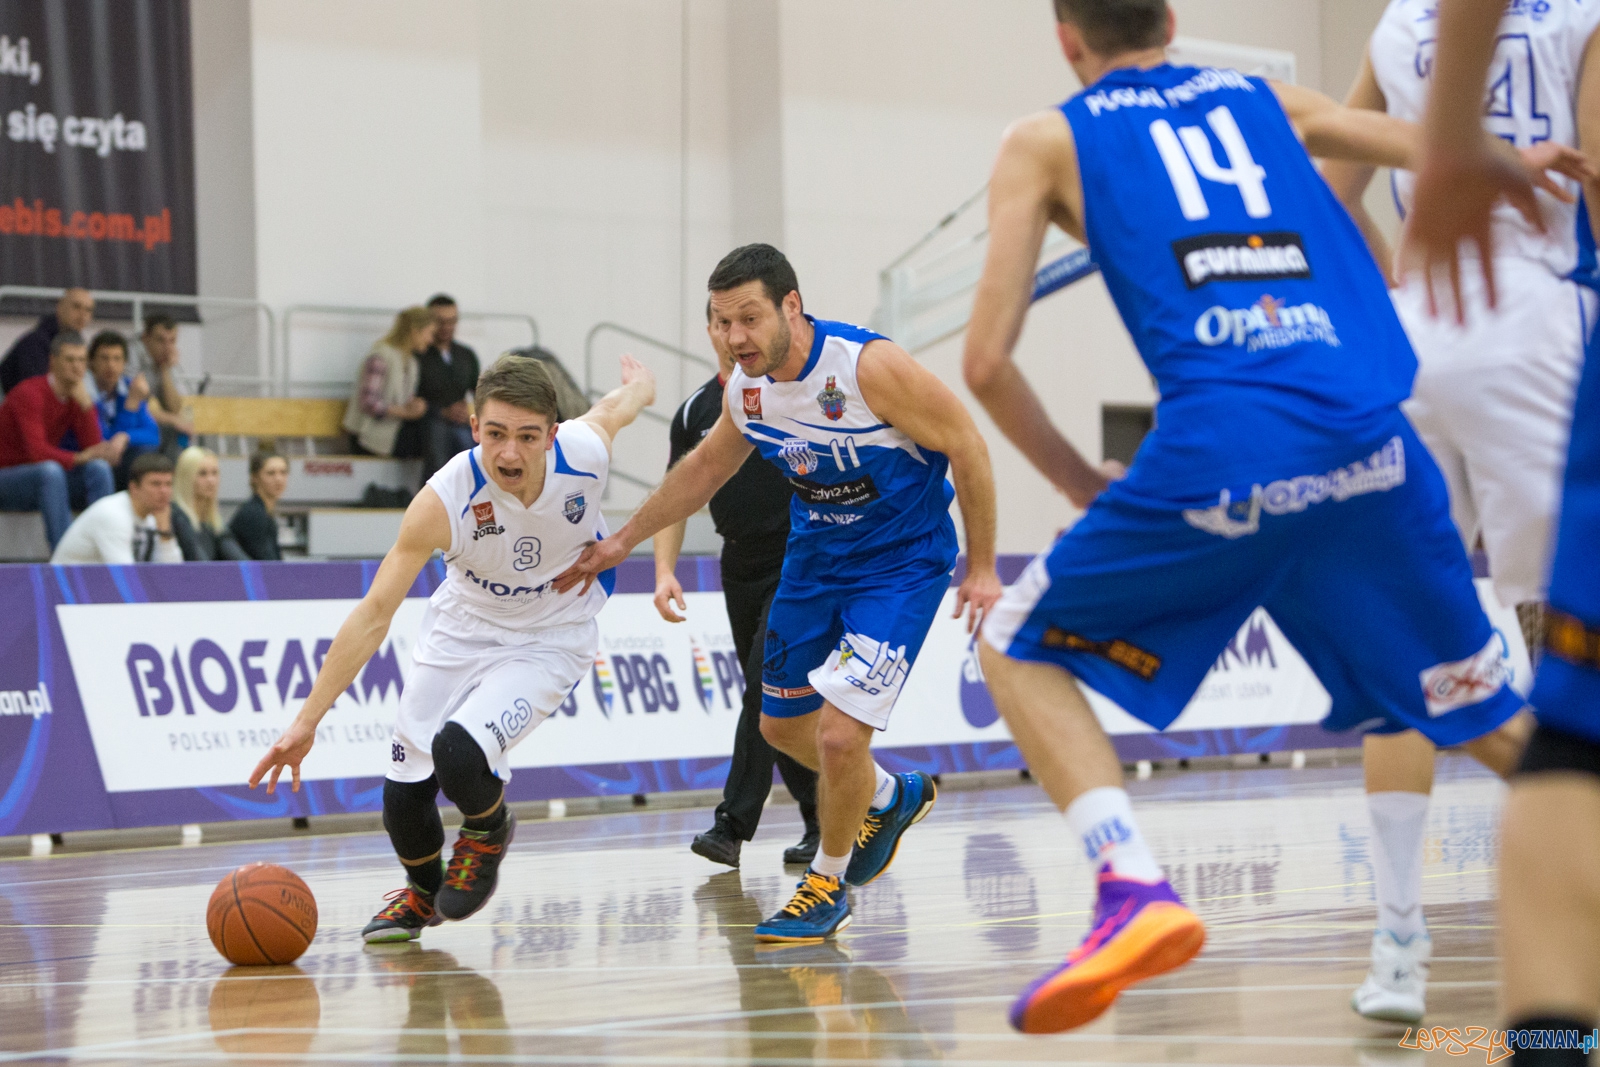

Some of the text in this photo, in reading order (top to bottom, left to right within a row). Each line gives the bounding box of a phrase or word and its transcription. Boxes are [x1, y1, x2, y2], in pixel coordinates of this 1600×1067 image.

[7, 102, 146, 157] się czyta
[1149, 105, 1272, 221] 14
[829, 436, 861, 472] 11
[513, 536, 541, 571] 3
[610, 652, 680, 714] PBG
[867, 641, 906, 687] 11
[501, 698, 532, 739] 3
[168, 729, 231, 752] POLSKI
